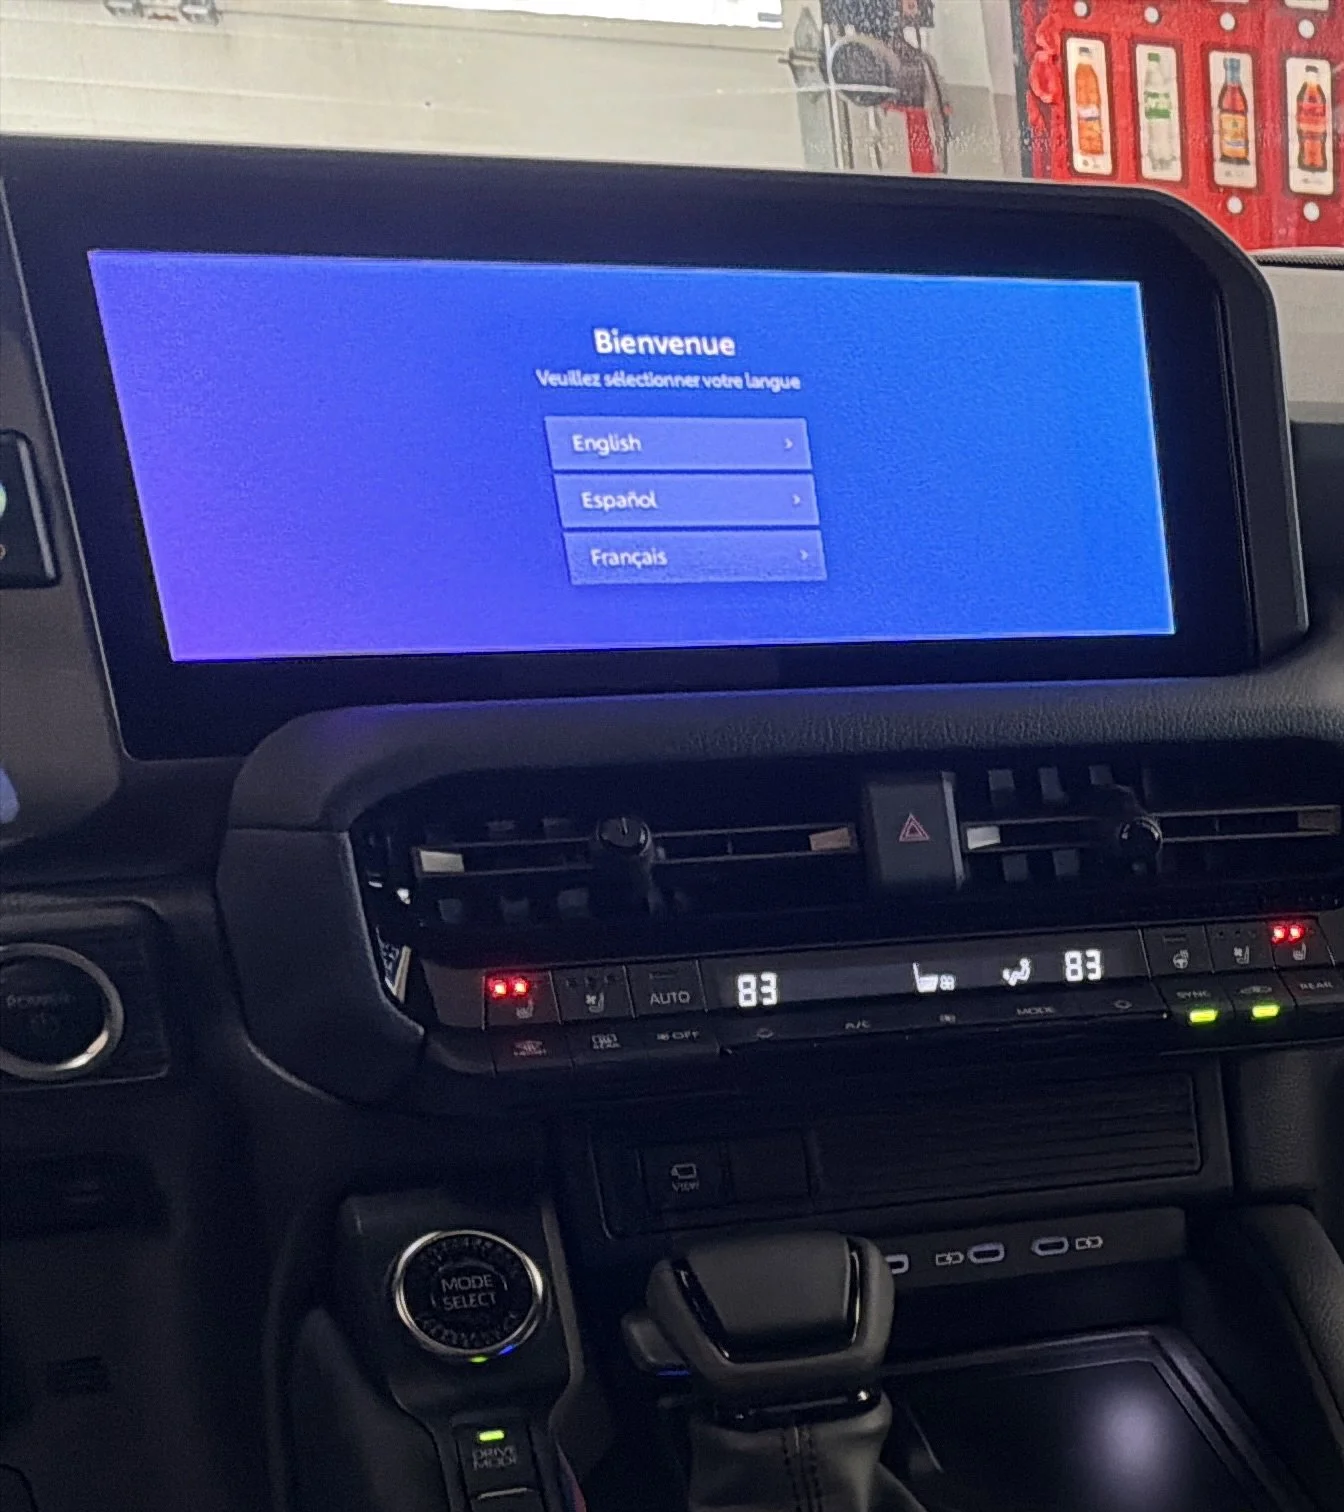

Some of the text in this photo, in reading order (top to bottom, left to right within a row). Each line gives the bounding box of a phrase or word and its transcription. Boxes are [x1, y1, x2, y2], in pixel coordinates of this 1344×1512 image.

[593, 328, 736, 356] Bienvenue
[535, 368, 802, 393] Veuillez sélectionner votre langue
[572, 432, 642, 456] English
[581, 489, 659, 512] Español
[590, 547, 669, 569] Français
[1064, 948, 1103, 983] 83
[737, 972, 778, 1008] 83
[1300, 981, 1334, 991] REAR
[649, 990, 692, 1006] AUTO
[1015, 1006, 1056, 1016] MODE
[440, 1273, 496, 1293] MODE
[443, 1291, 498, 1312] SELECT
[472, 1445, 516, 1460] DRIVE
